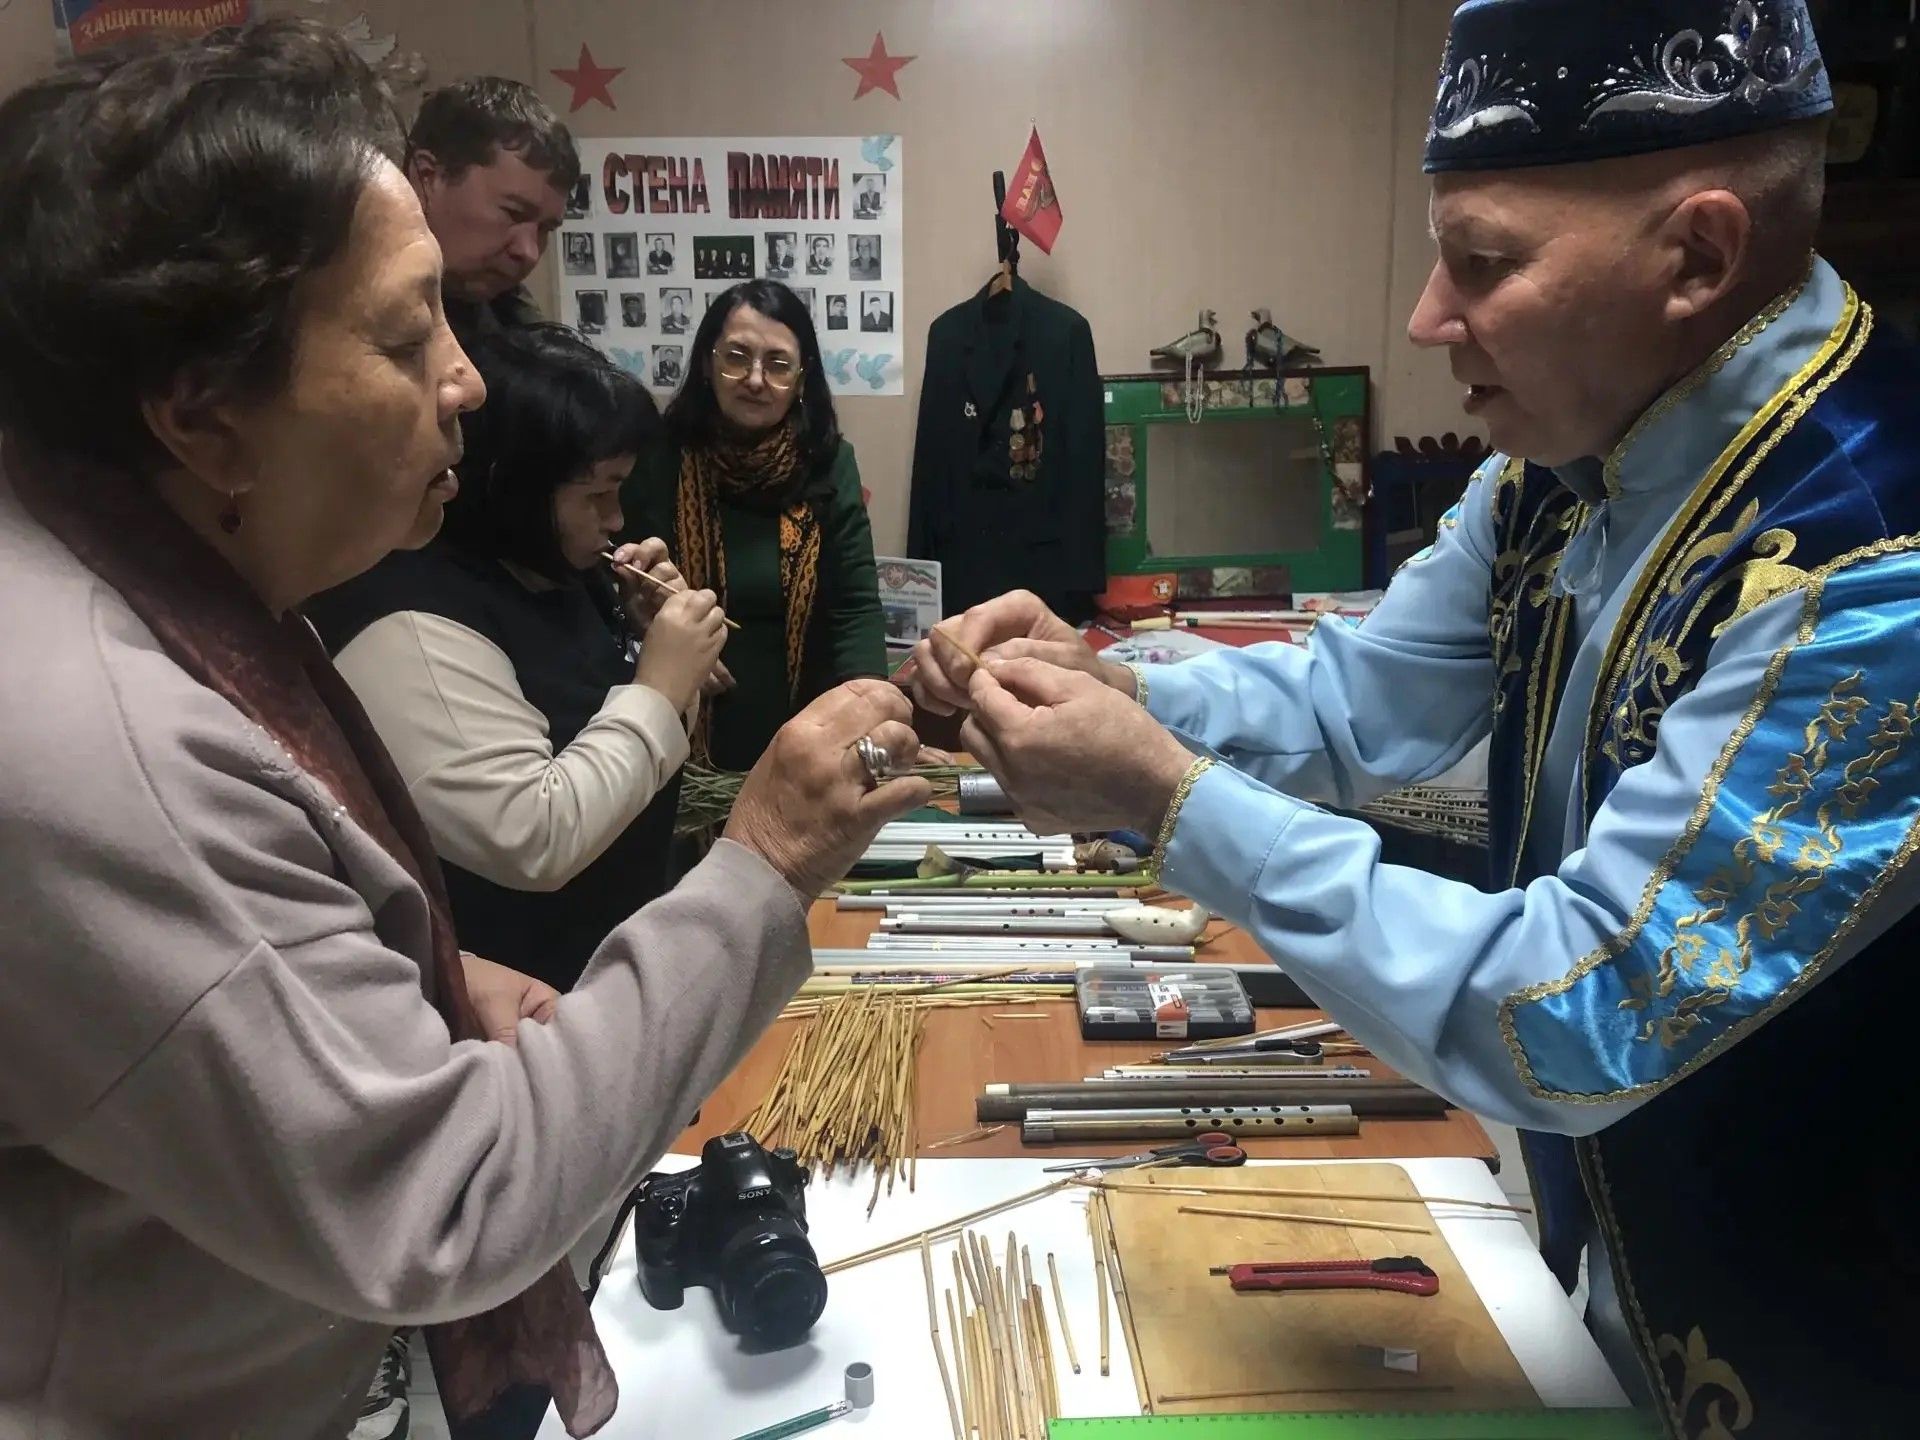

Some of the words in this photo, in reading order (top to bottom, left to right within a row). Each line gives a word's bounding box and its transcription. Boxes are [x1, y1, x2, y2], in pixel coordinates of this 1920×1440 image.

[80, 0, 241, 39] ЗАЩИТНИКАМИ!
[603, 152, 711, 214] СТЕНА
[727, 151, 840, 219] ПАМЯТИ
[738, 1187, 772, 1200] SONY
